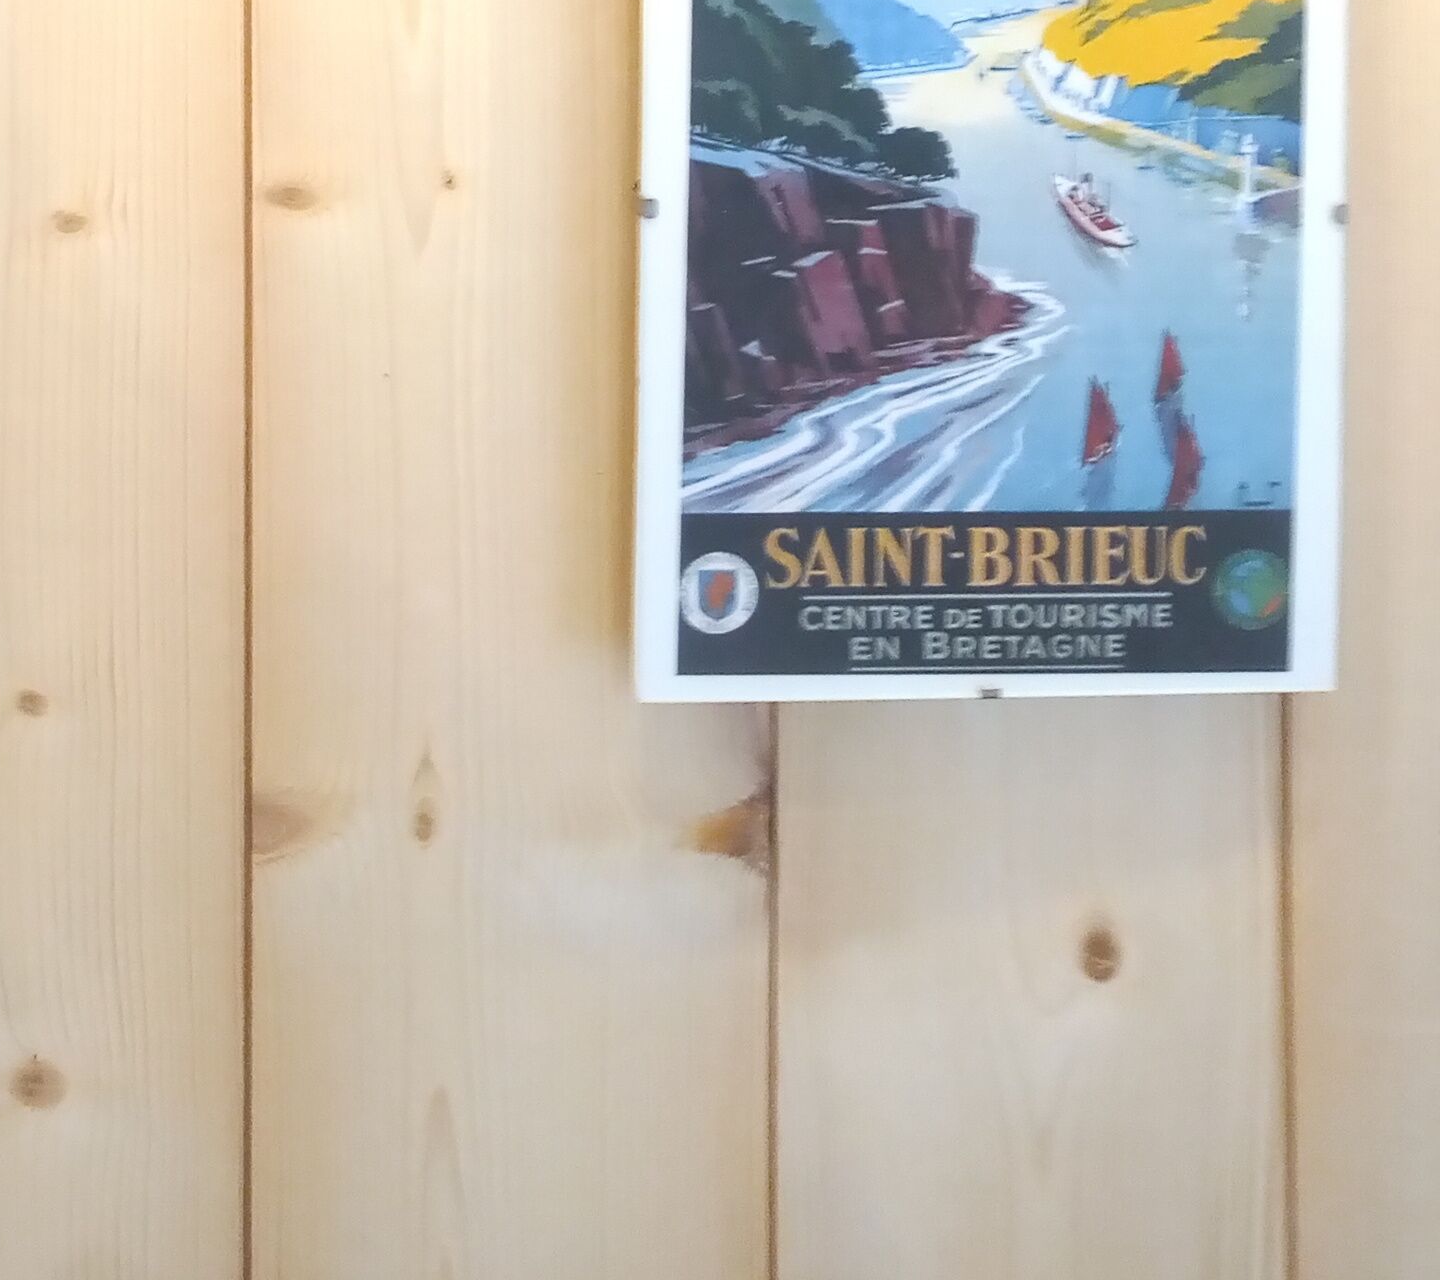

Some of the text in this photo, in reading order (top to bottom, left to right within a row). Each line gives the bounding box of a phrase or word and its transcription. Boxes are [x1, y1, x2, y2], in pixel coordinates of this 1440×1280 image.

[763, 523, 1209, 590] SAINT-BRIEUC
[797, 603, 1175, 633] CENTRE DE TOURISME
[847, 631, 1128, 663] EN BRETAGNE
